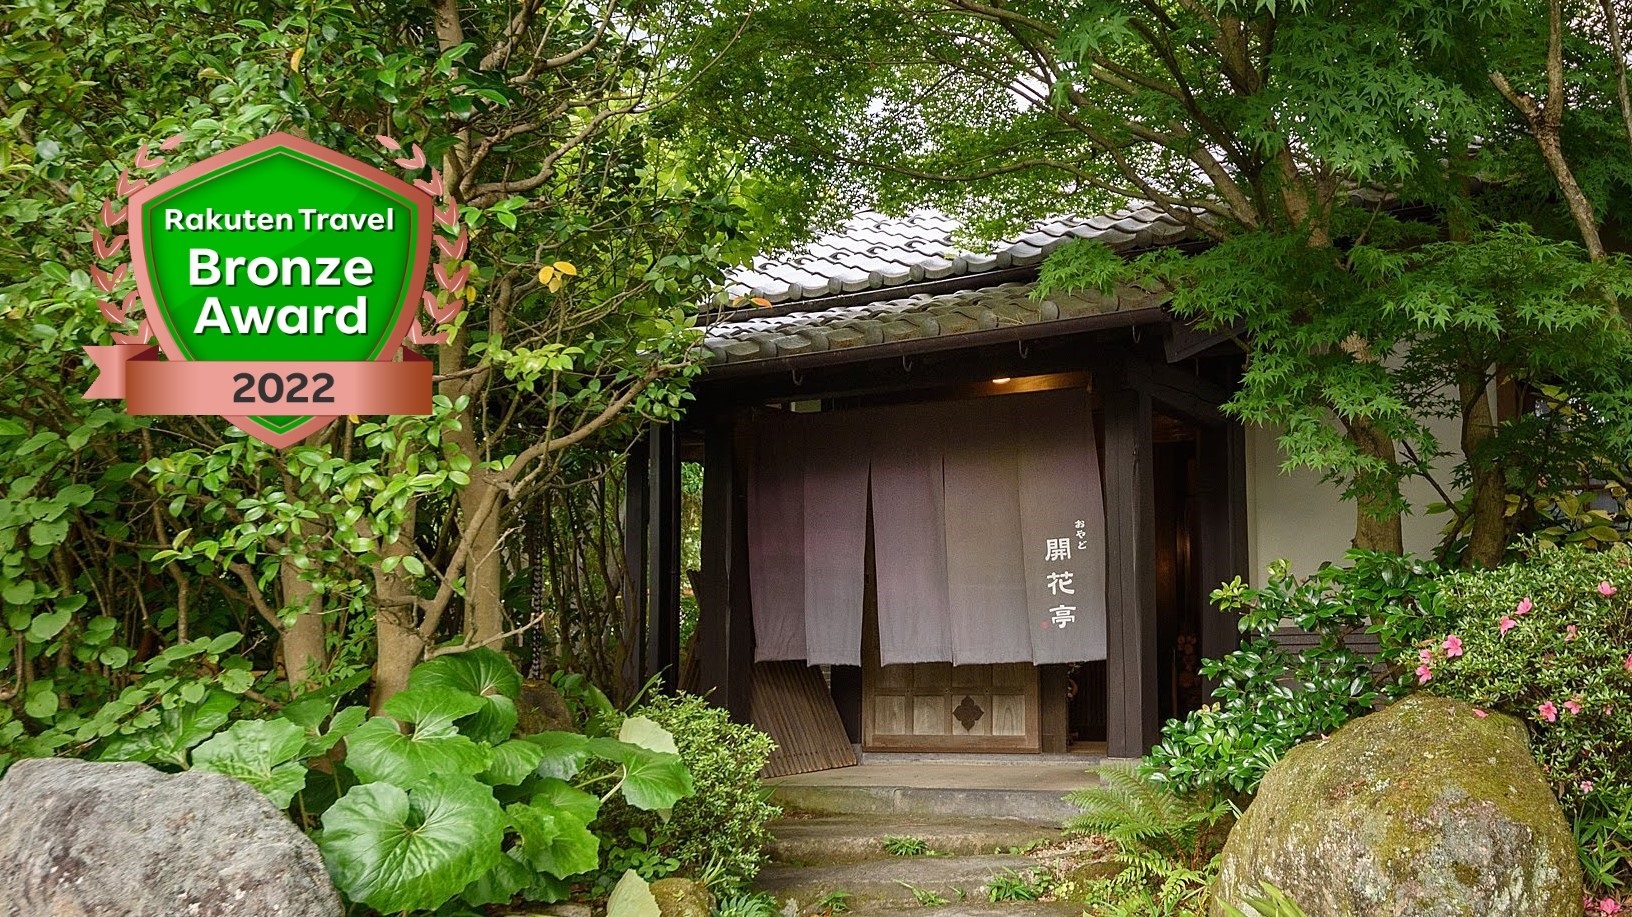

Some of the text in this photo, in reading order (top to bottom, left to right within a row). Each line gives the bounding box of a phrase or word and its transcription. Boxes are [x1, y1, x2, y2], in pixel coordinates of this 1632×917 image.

[1074, 519, 1088, 550] おやど
[1045, 537, 1077, 629] 開花亭
